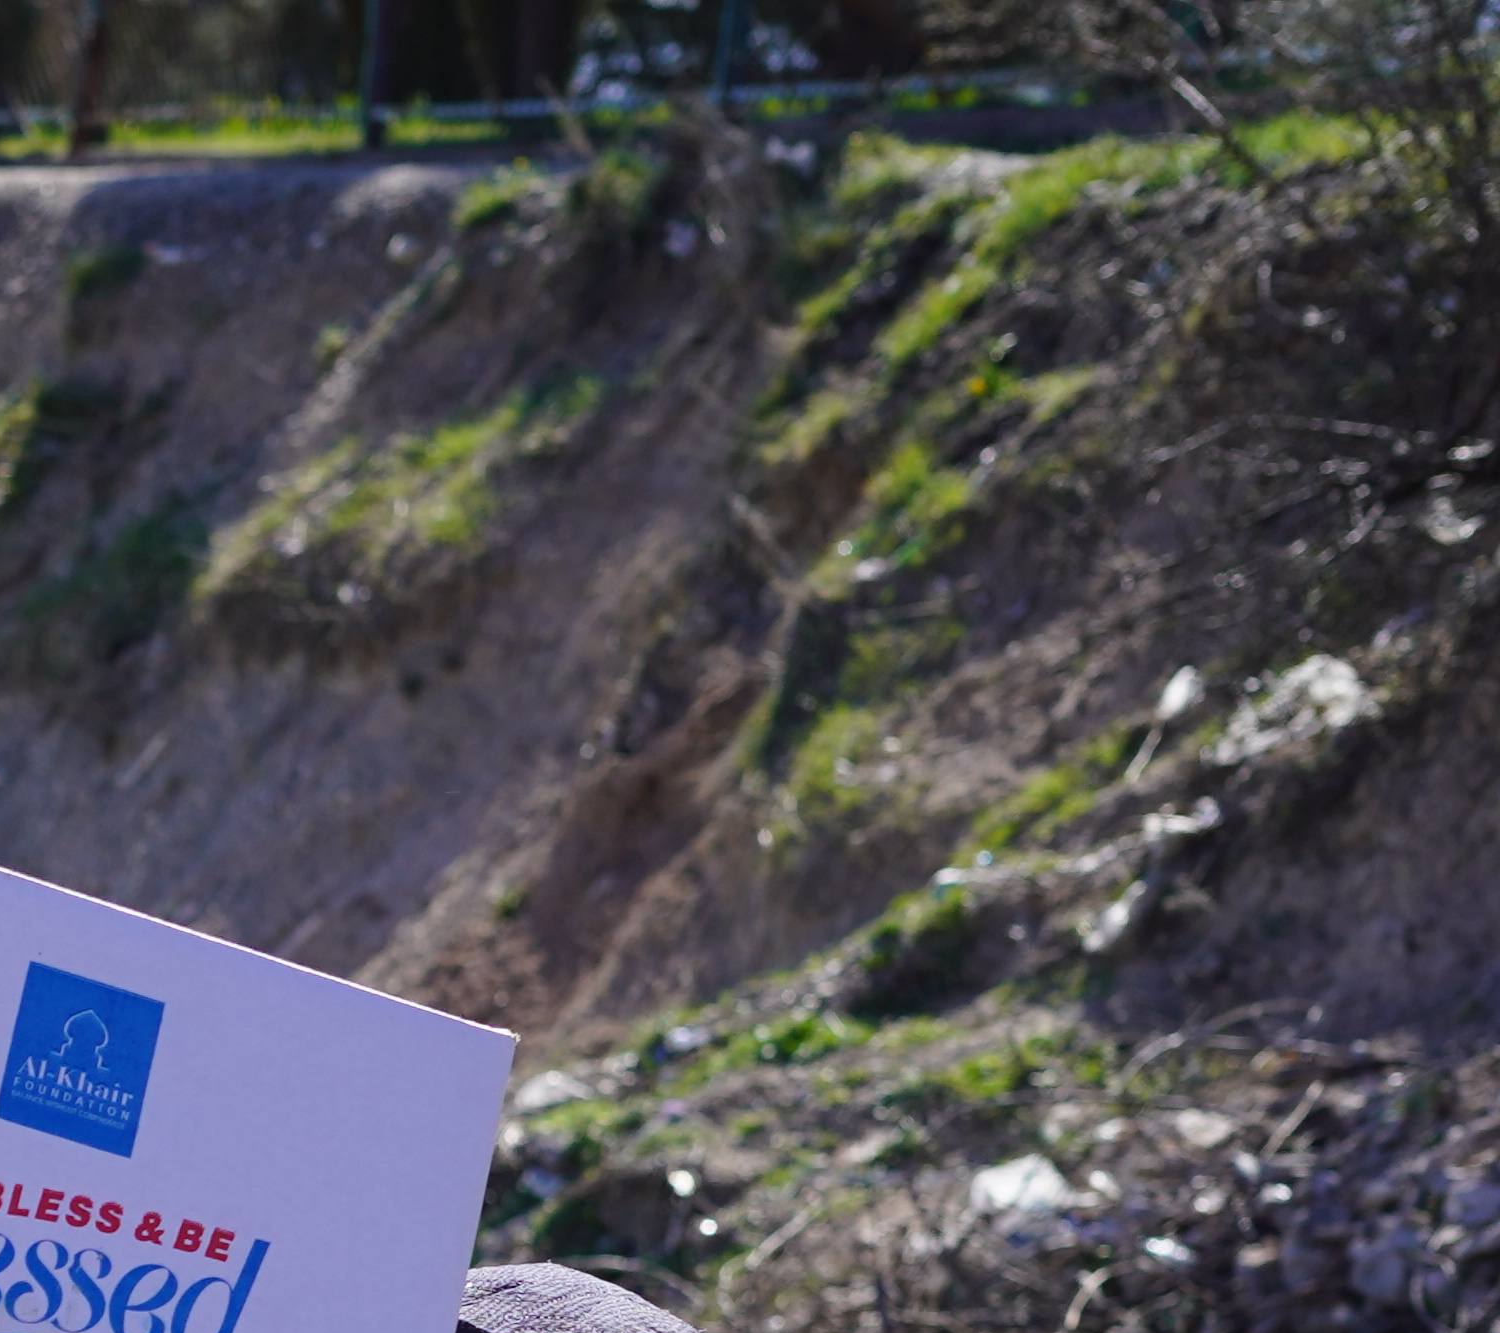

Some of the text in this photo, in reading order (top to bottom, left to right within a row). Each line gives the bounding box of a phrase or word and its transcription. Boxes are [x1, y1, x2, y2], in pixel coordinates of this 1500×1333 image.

[12, 1076, 130, 1121] FOUNDATION
[17, 1055, 134, 1106] Al-Khair
[134, 1211, 165, 1246] &
[173, 1219, 235, 1262] BE
